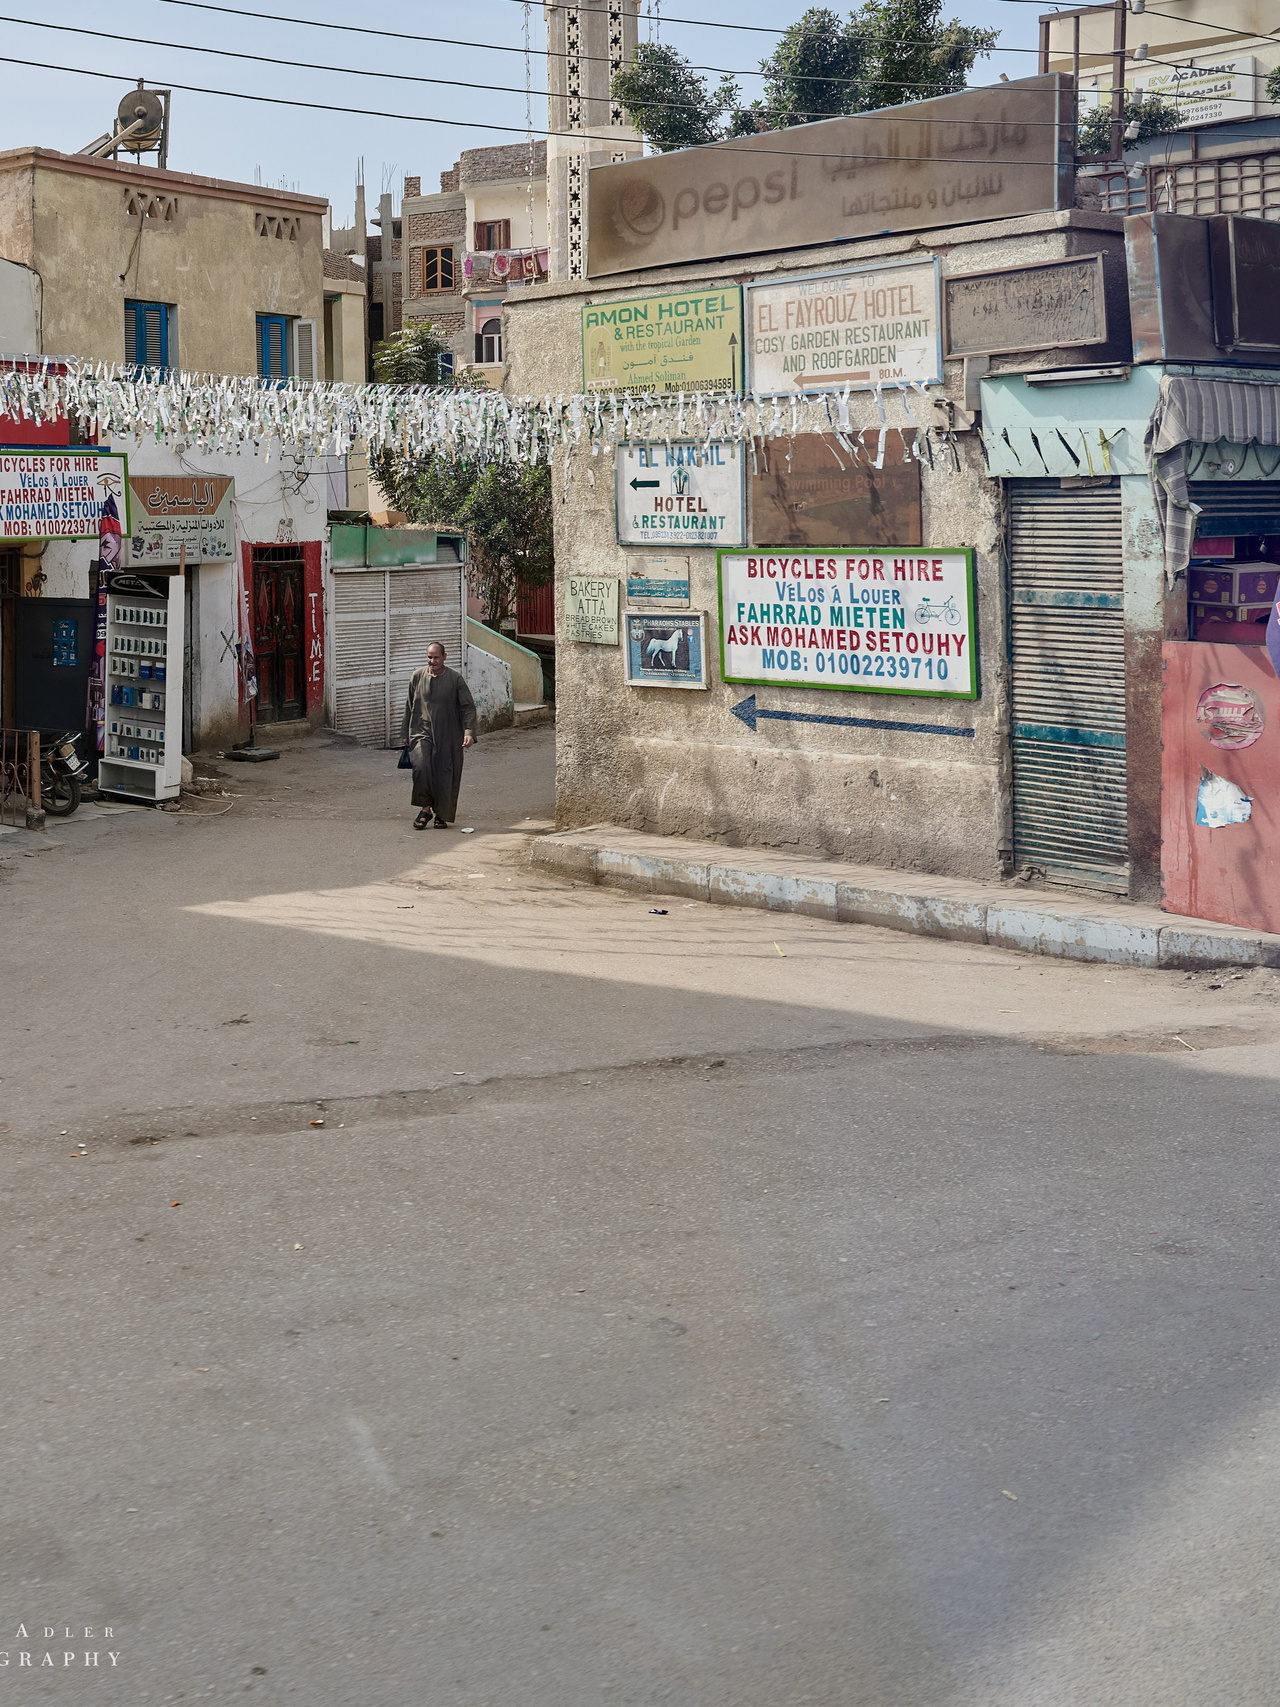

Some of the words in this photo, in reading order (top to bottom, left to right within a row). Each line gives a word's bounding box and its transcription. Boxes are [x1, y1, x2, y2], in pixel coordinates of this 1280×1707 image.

[1171, 63, 1236, 83] ACADEMY
[671, 157, 799, 231] pepsi
[798, 278, 853, 297] WELCOME
[860, 275, 875, 288] TO
[586, 303, 649, 329] AMON
[658, 294, 735, 321] HOTEL
[758, 304, 778, 333] EL
[785, 292, 858, 330] FAYROUZ
[864, 284, 922, 320] HOTEL
[614, 327, 624, 341] &
[626, 315, 725, 340] RESTAURANT
[755, 335, 786, 355] COSY
[791, 329, 840, 351] GARDEN
[845, 319, 931, 346] RESTAURANT
[620, 341, 635, 352] with
[635, 340, 647, 351] the
[648, 337, 674, 353] tropical
[675, 335, 701, 348] Garden
[622, 353, 657, 370] آمون
[660, 352, 694, 367] فندق
[782, 354, 806, 373] AND
[812, 344, 897, 371] ROOFGARDEN
[627, 371, 654, 385] Ahmed
[655, 369, 687, 383] Soliman
[878, 367, 907, 380] 80.M.
[587, 380, 618, 388] AMON
[50, 457, 71, 472] FOR
[74, 457, 99, 472] HIRE
[639, 447, 659, 467] EL
[781, 475, 851, 492] Swimming
[855, 474, 886, 489] Pool
[0, 488, 51, 505] FAHRRAD
[55, 487, 95, 502] MIETEN
[148, 481, 215, 514] الياسمين
[654, 496, 708, 513] HOTEL
[6, 503, 60, 521] MOHAMED
[62, 502, 105, 519] SETOUH
[4, 521, 32, 536] MOB:
[35, 519, 102, 536] 01002239710
[641, 515, 726, 530] RESTAURANT
[747, 558, 838, 581] BICYCLES
[845, 558, 885, 581] FOR
[893, 559, 944, 582] HIRE
[570, 580, 612, 598] BAKERY
[578, 598, 606, 615] ATTA
[565, 614, 590, 623] BREAD
[591, 616, 617, 625] BROWN
[674, 619, 700, 627] STABLES
[737, 602, 821, 626] FAHRRAD
[830, 606, 906, 630] MIETEN
[565, 629, 603, 639] PASTRIES
[588, 623, 615, 632] CAKES
[727, 625, 763, 647] ASK
[766, 626, 861, 652] MOHAMED
[865, 631, 967, 657] SETOUHY
[762, 648, 808, 672] MOB:
[815, 651, 949, 681] 01002239710
